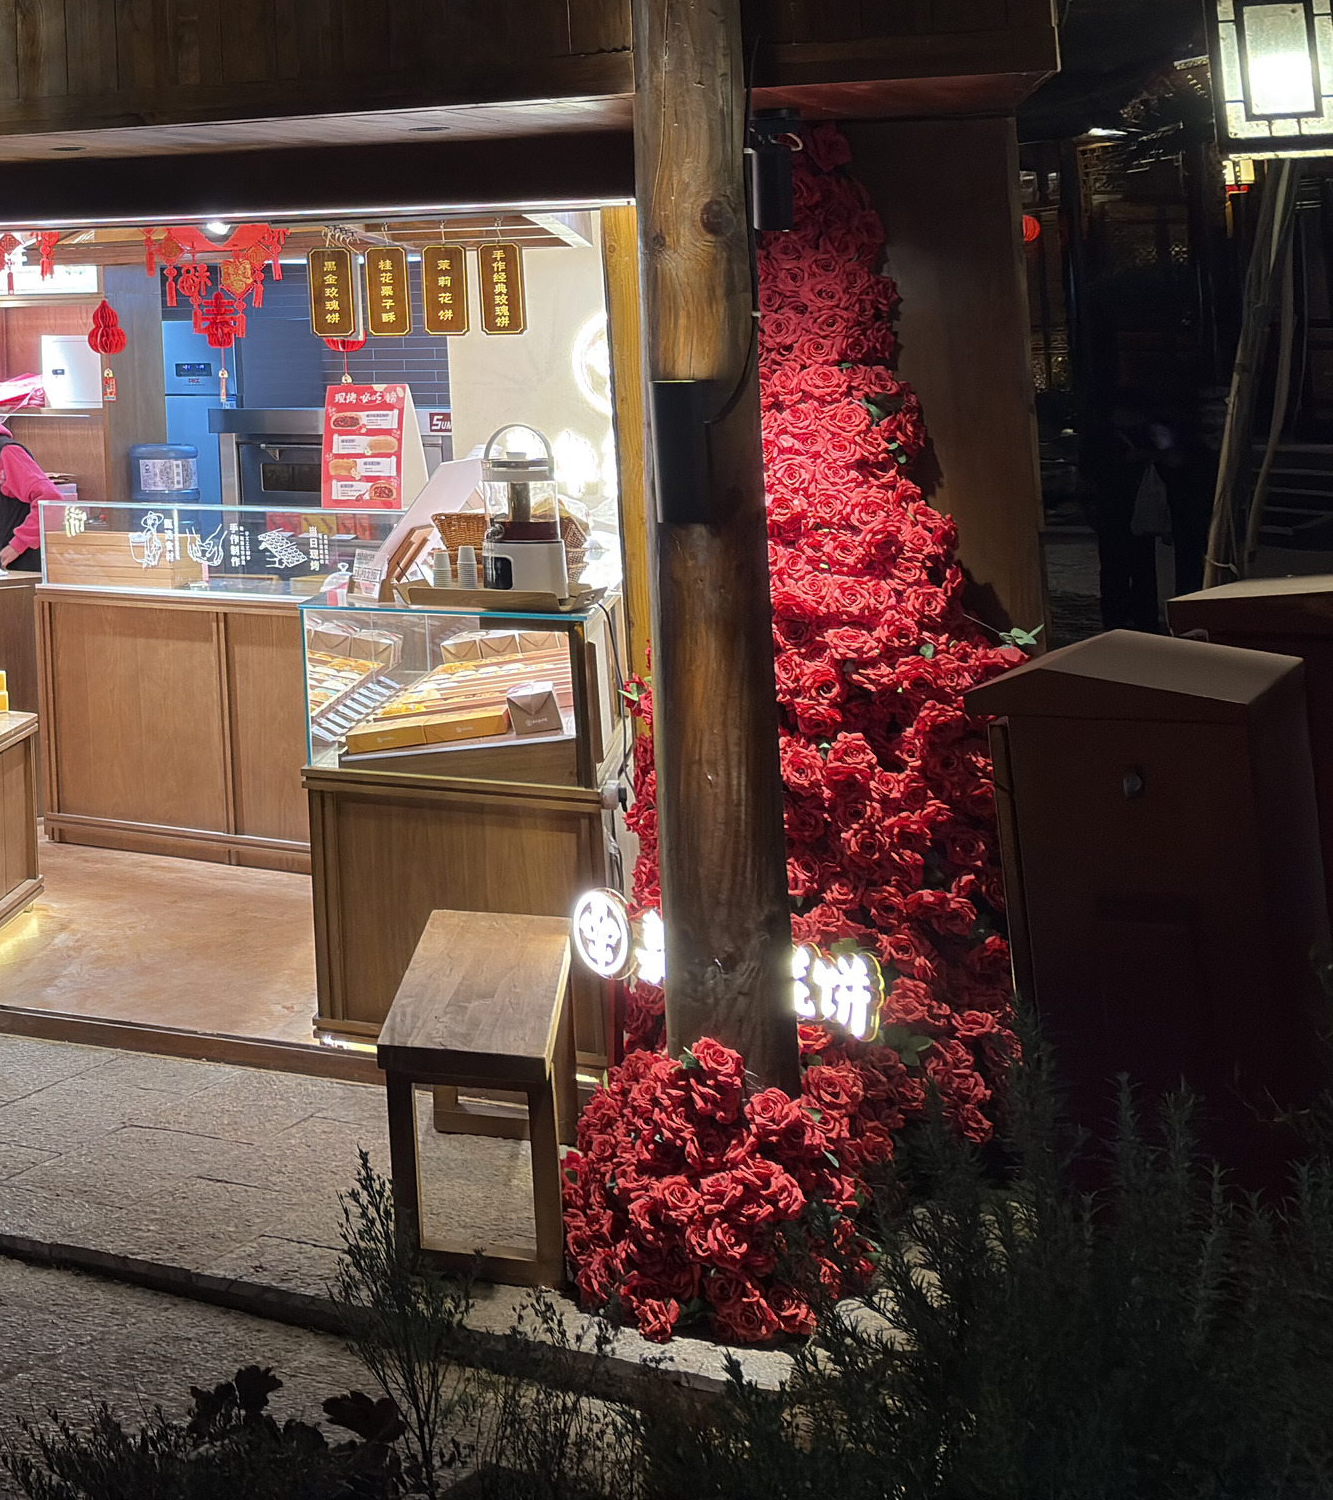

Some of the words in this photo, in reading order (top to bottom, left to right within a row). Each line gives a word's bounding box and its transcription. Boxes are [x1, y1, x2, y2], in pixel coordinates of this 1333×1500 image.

[323, 261, 340, 324] 黑金玫瑰饼
[437, 259, 454, 322] 茉莉花饼
[492, 250, 510, 328] 手作经典玫瑰饼
